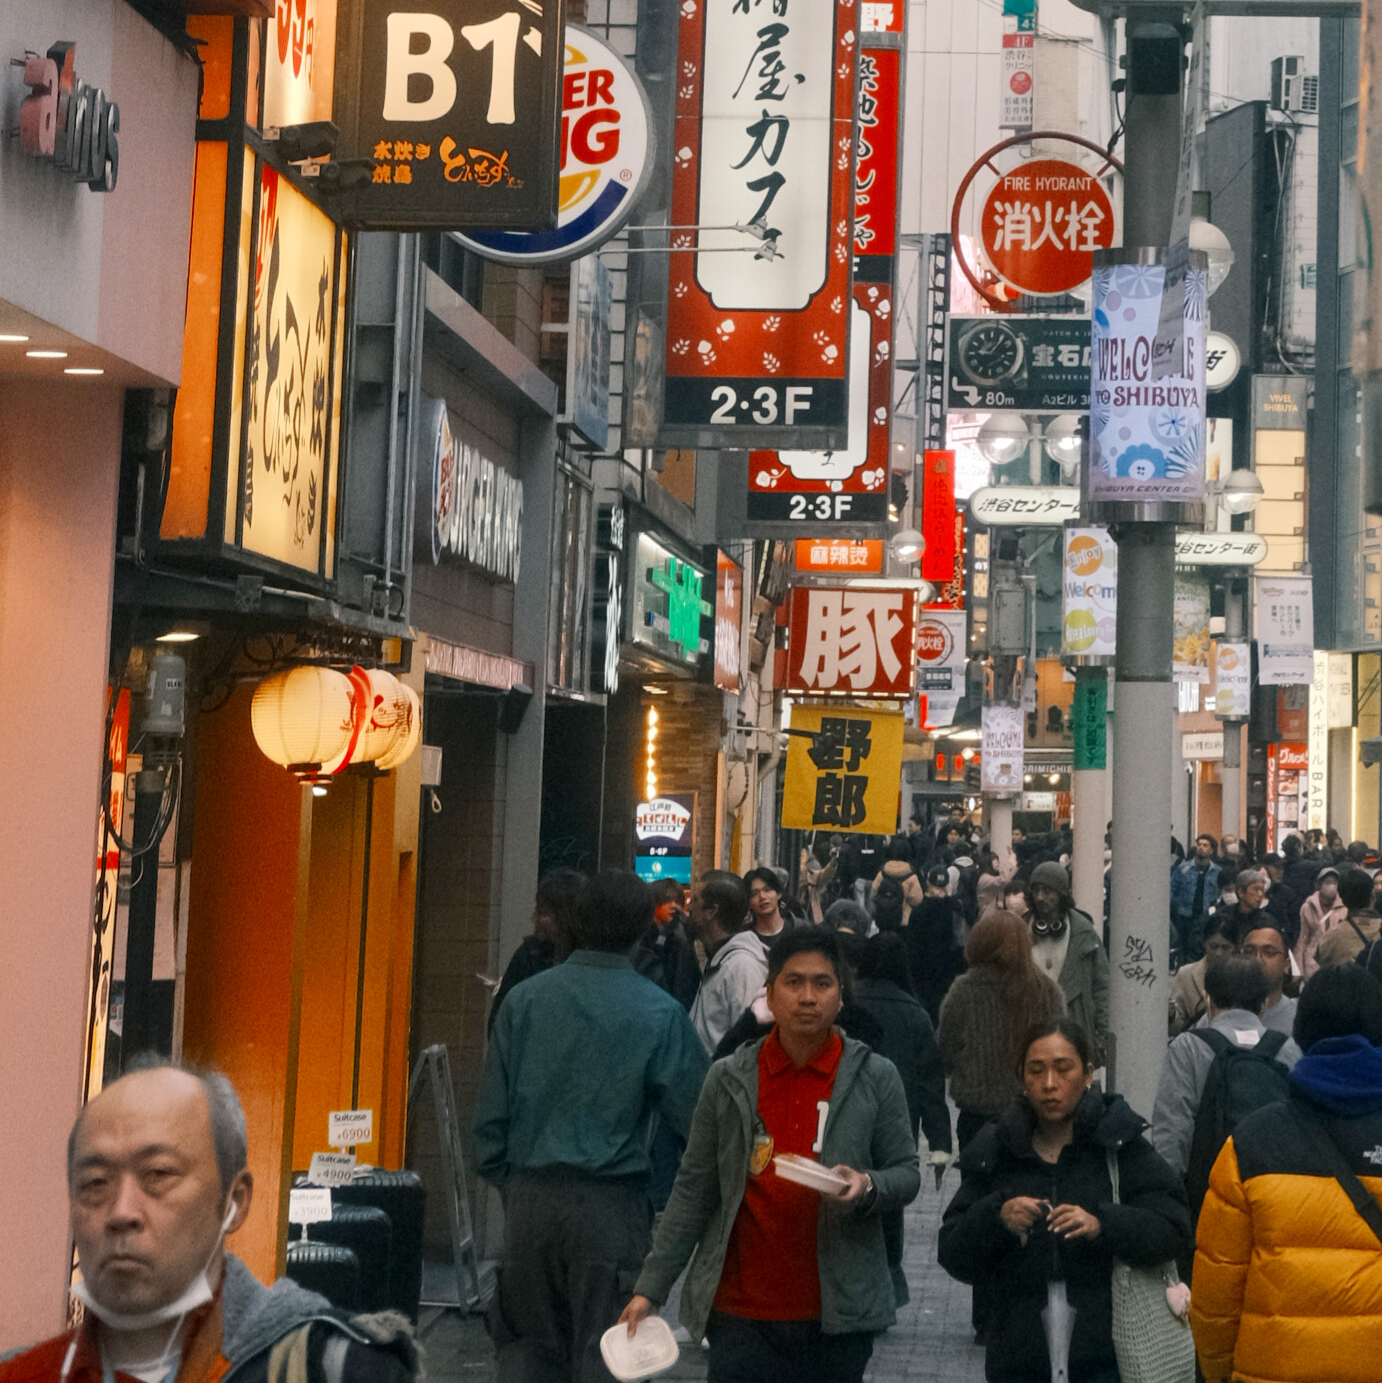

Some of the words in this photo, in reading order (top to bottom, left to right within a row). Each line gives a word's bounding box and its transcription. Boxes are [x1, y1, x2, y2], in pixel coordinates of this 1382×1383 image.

[382, 12, 521, 125] B1
[1004, 176, 1031, 192] FIRE
[1036, 176, 1094, 192] HYDRANT
[993, 199, 1105, 252] 消火栓
[1098, 335, 1195, 383] WELCE
[985, 391, 1015, 406] 80m
[1113, 385, 1200, 409] SHIBUYA
[1263, 403, 1299, 413] SHIBUYA
[799, 589, 905, 691] 豚
[807, 716, 872, 829] 野郎
